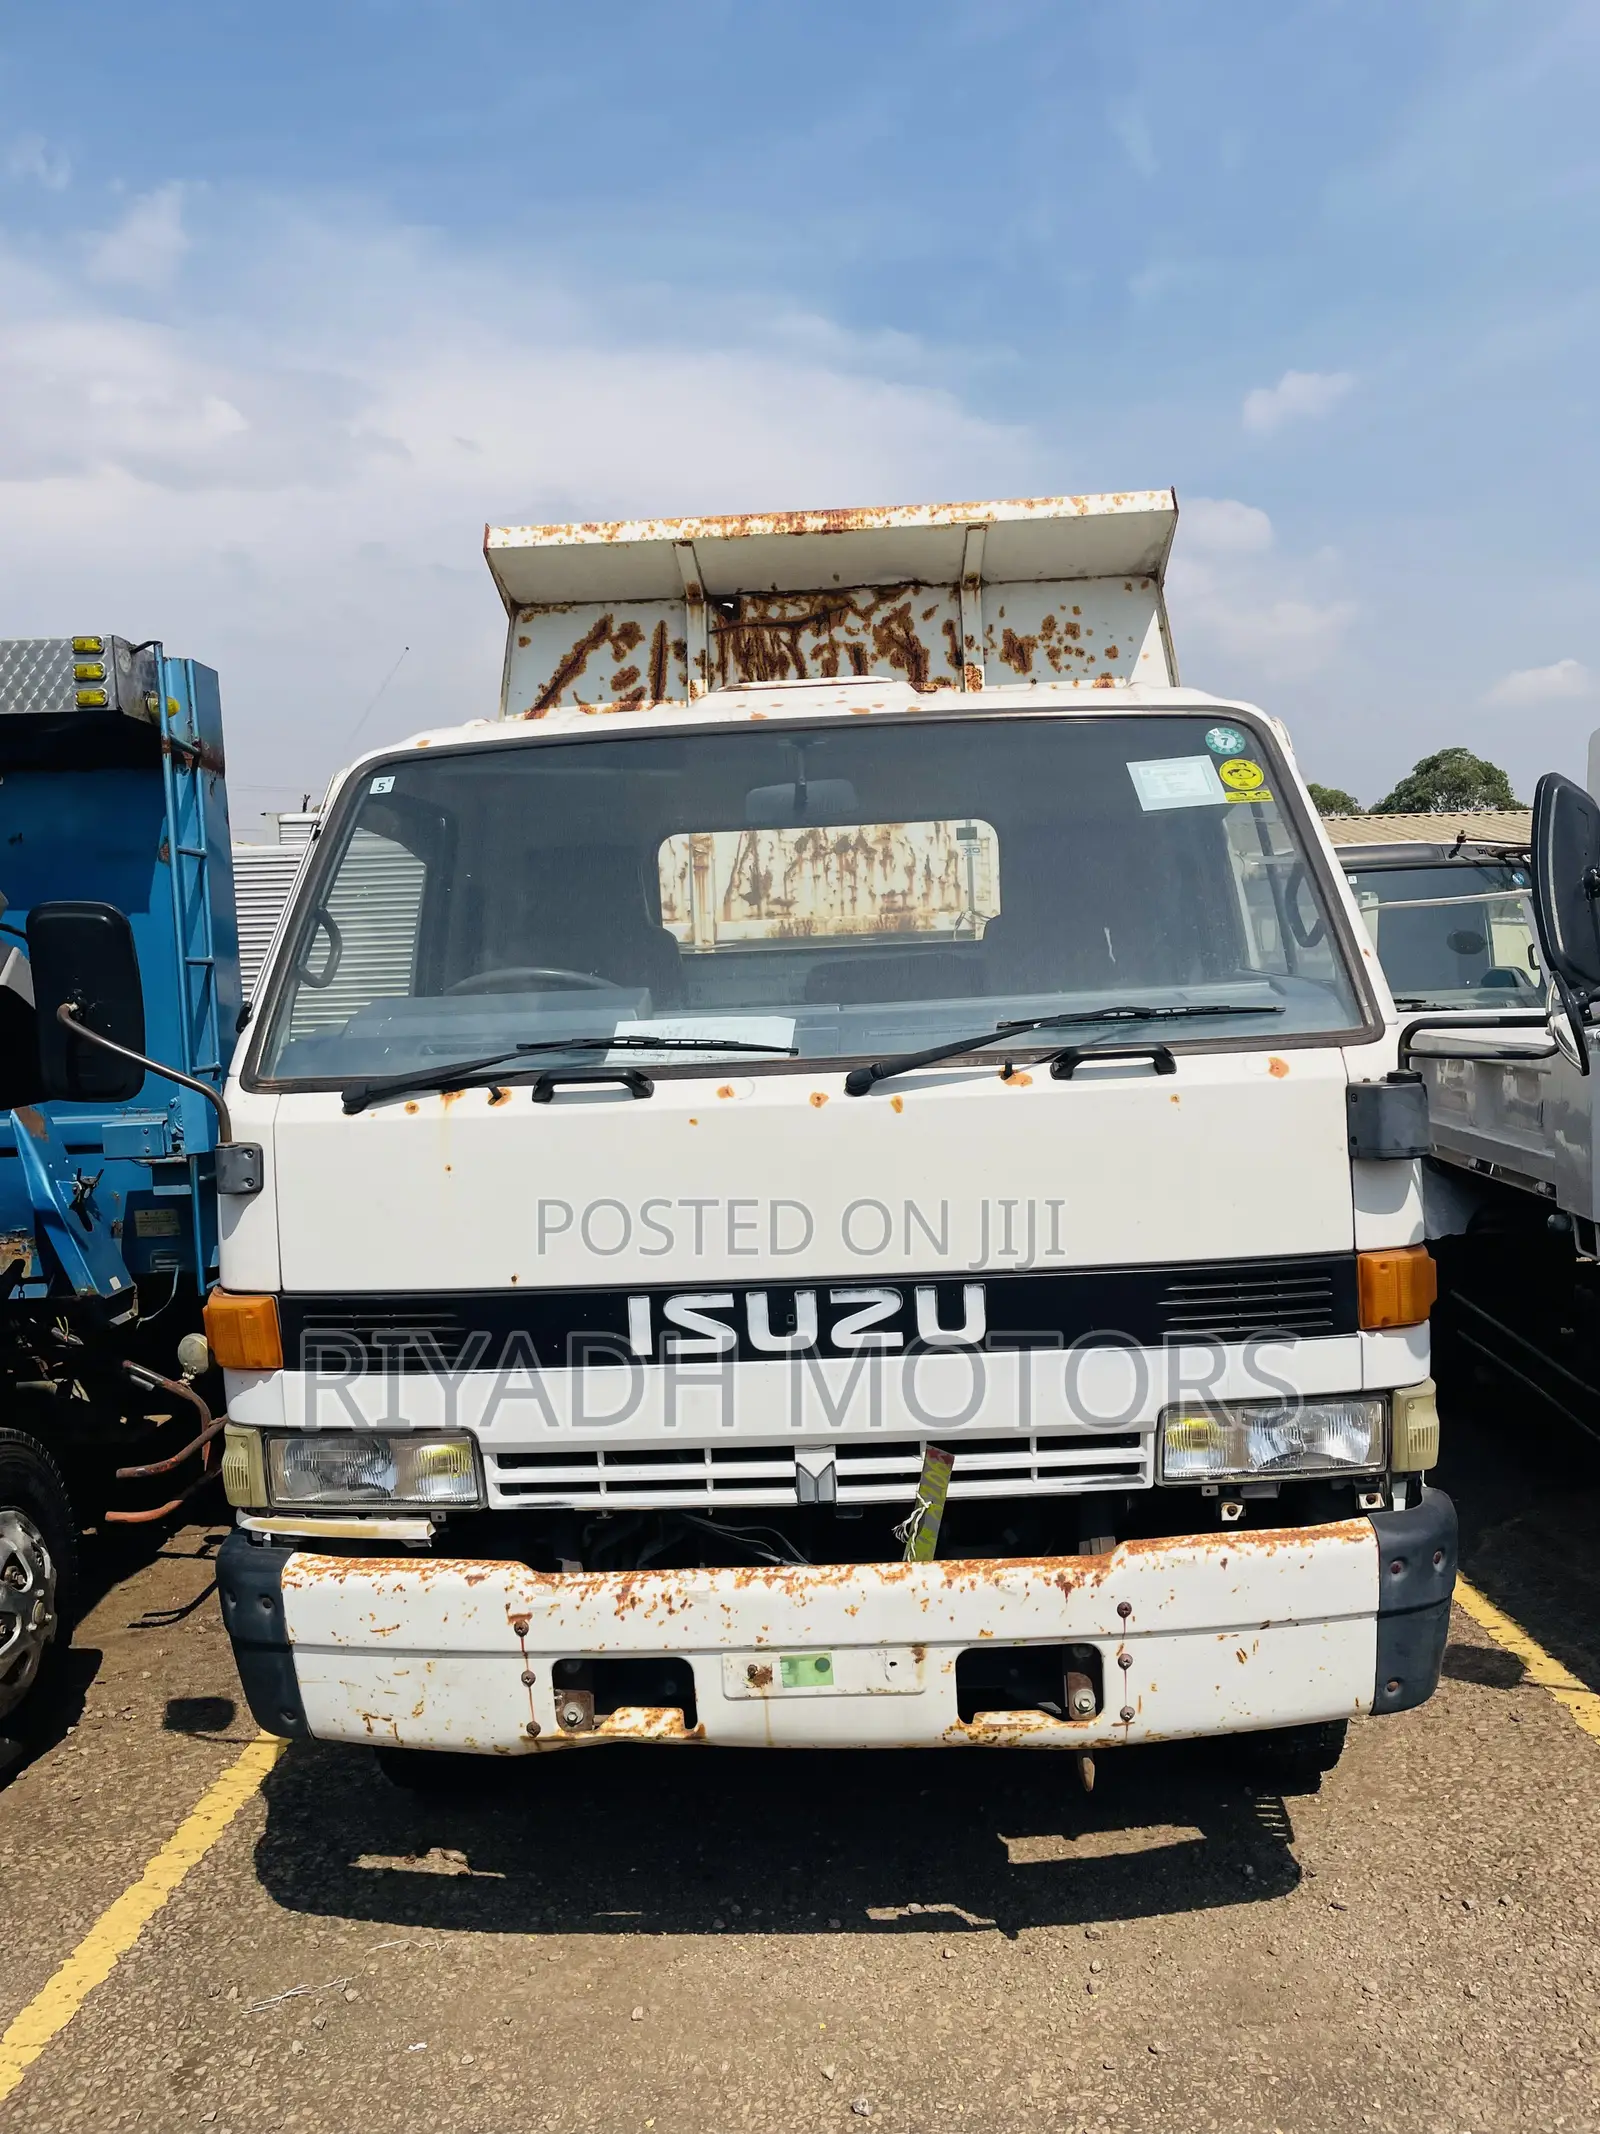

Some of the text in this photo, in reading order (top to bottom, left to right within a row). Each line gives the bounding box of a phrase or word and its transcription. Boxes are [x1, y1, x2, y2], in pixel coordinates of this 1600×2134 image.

[1221, 737, 1229, 746] 7
[376, 782, 386, 792] 5
[628, 1284, 987, 1356] ISUZU
